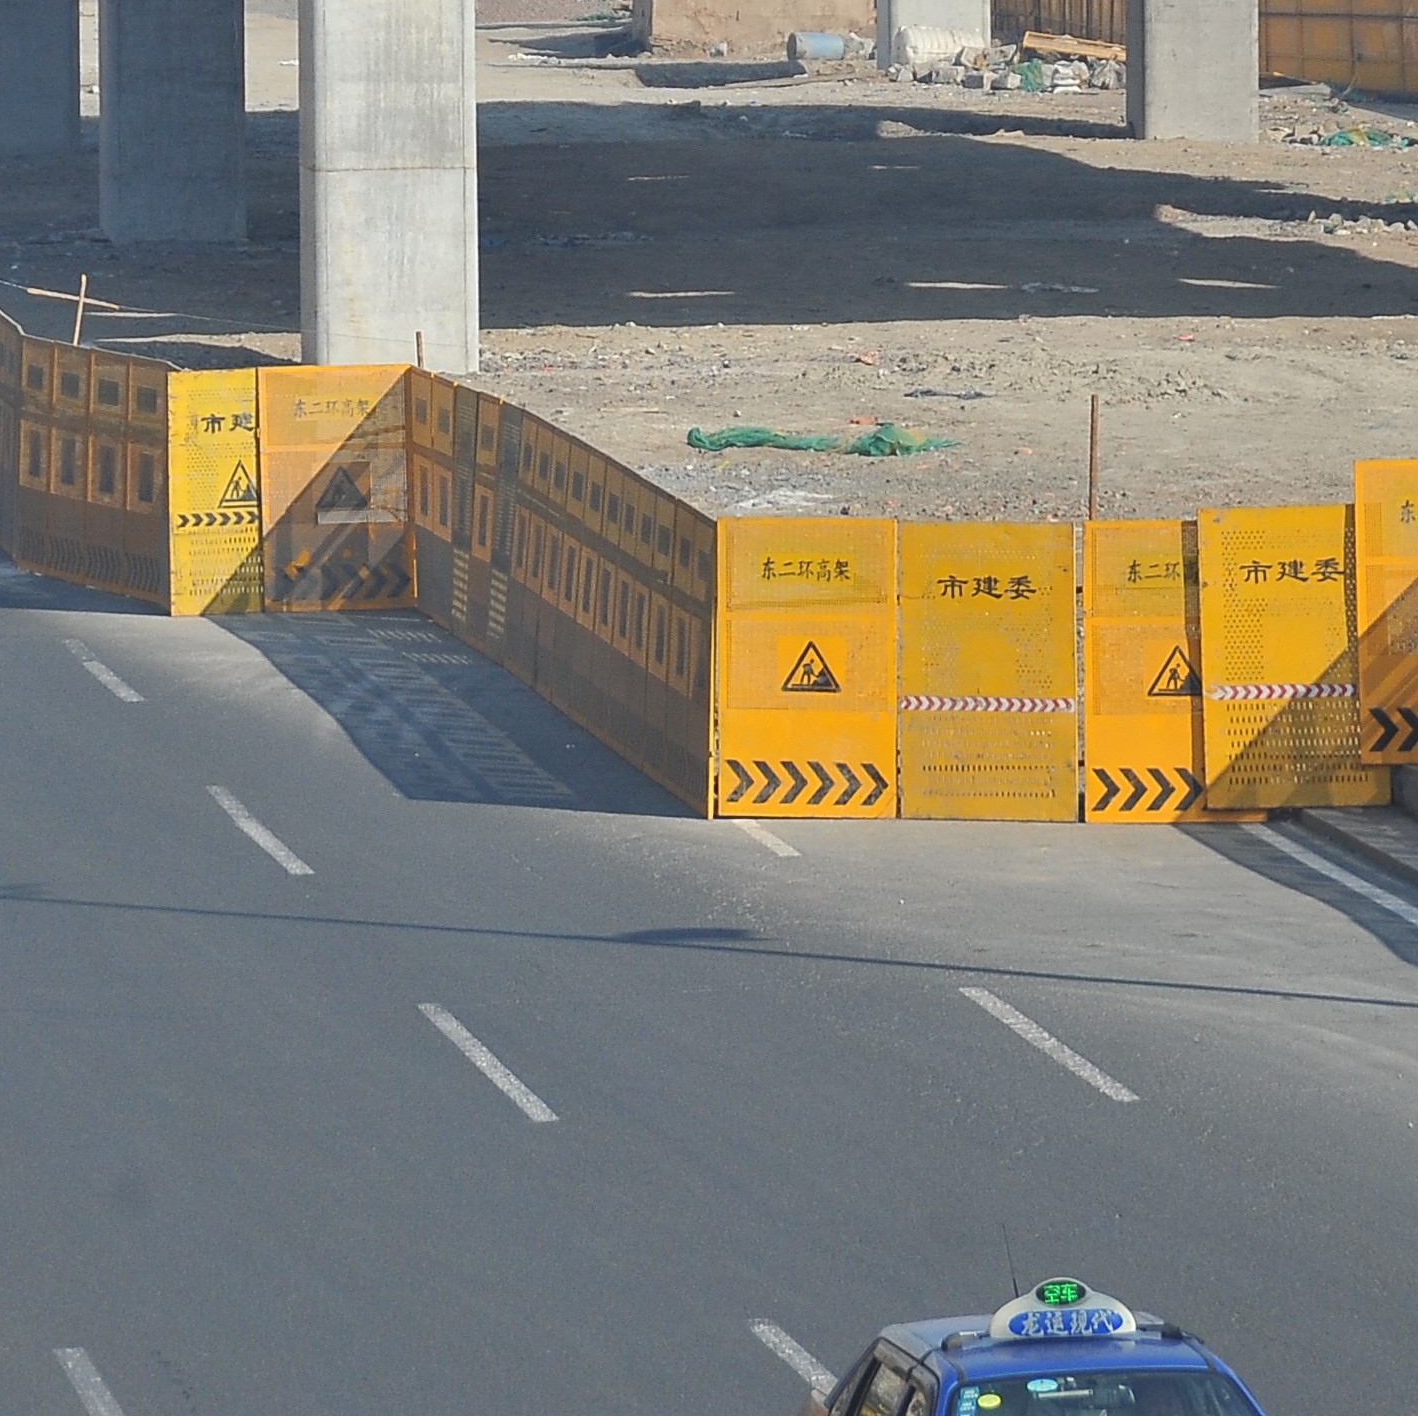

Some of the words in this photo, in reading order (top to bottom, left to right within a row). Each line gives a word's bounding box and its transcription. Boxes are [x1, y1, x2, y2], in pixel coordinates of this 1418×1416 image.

[293, 398, 370, 418] 东二环高架
[761, 557, 851, 582] 东二环高架
[1238, 558, 1346, 585] 市建委
[936, 574, 1037, 600] 市建委
[1044, 1283, 1079, 1303] 空车
